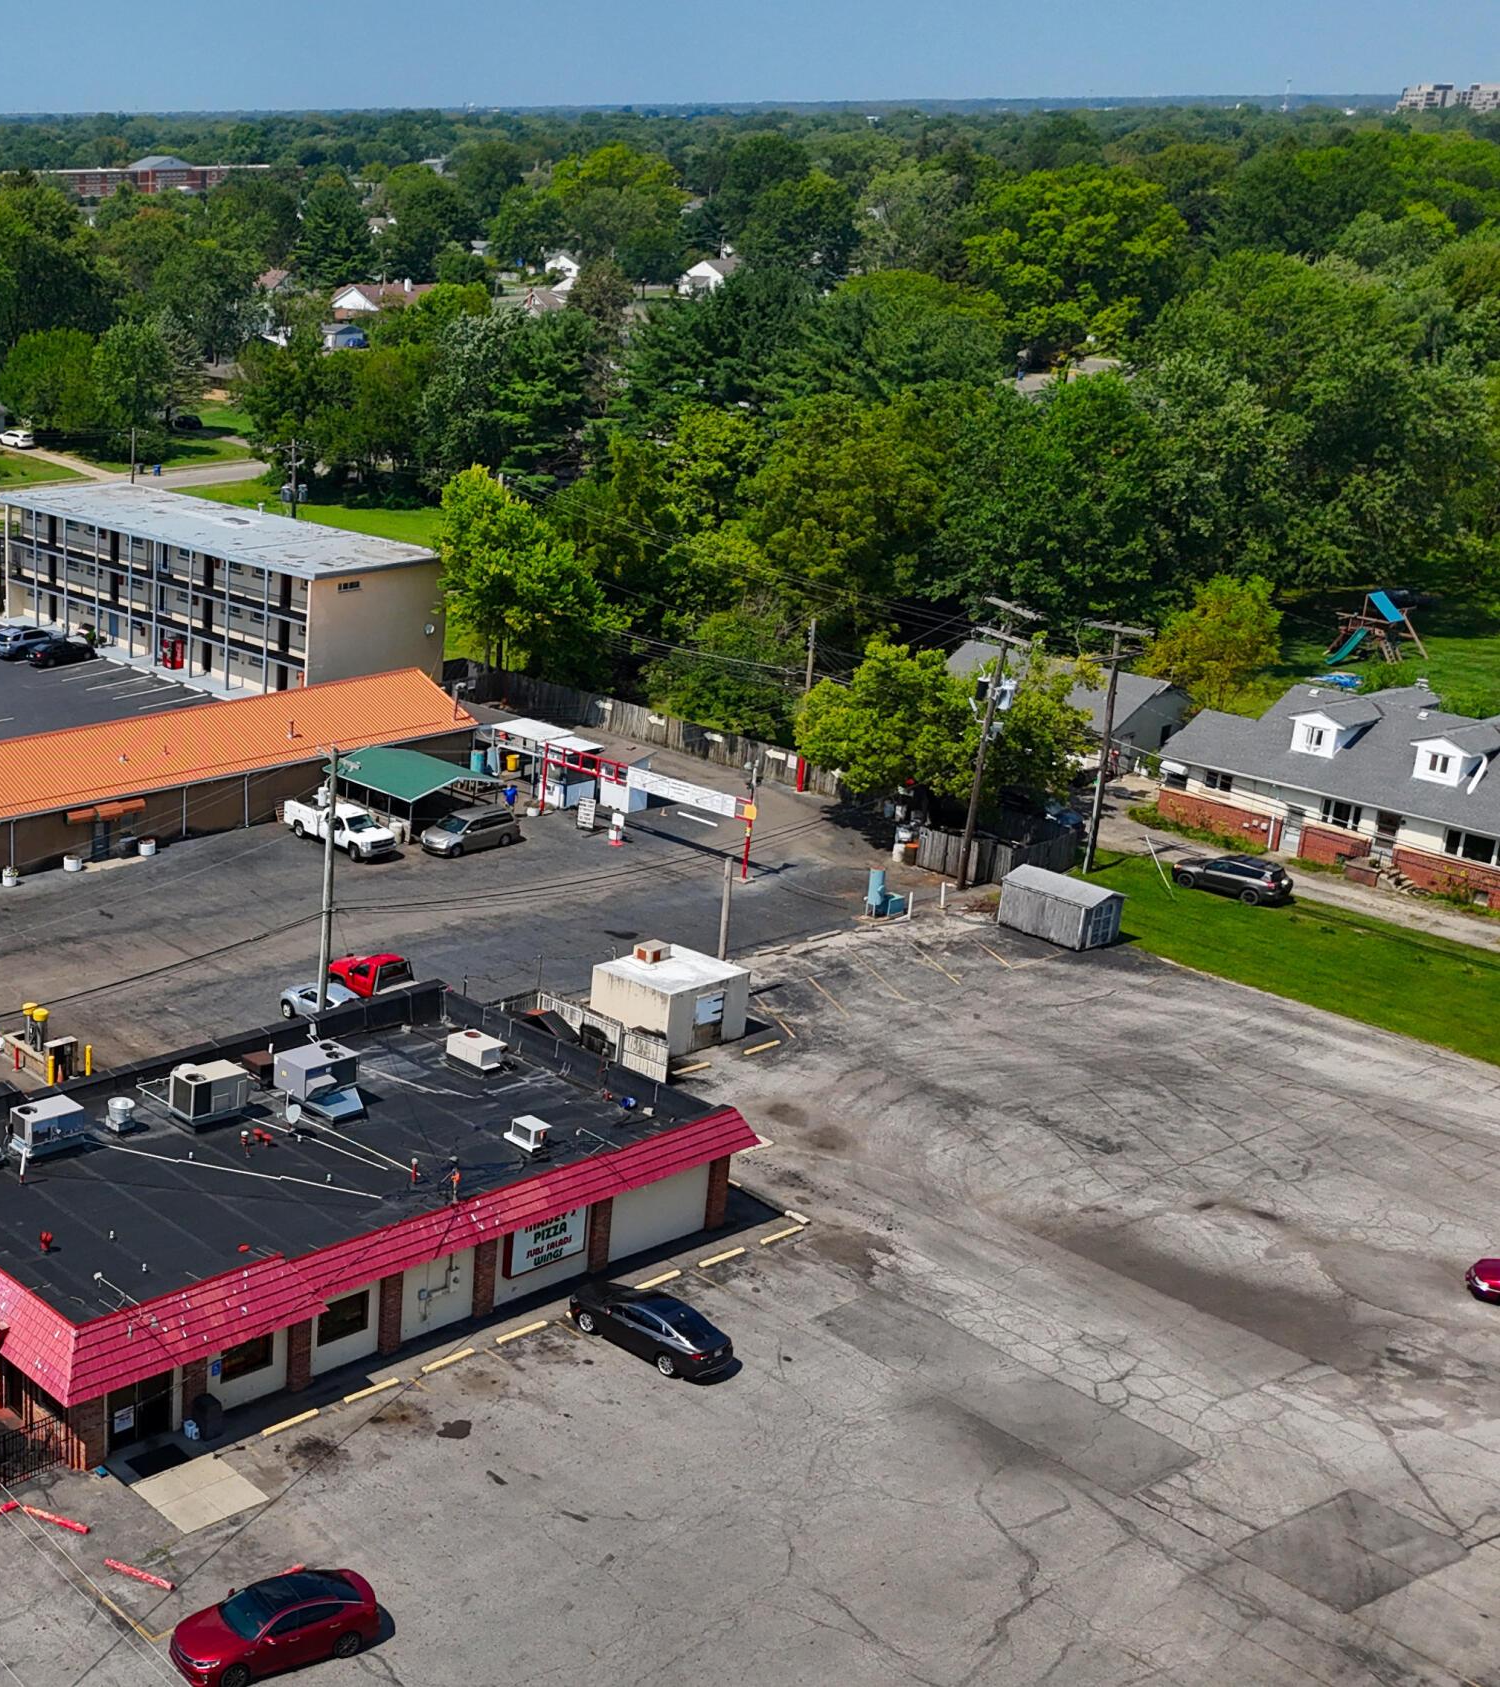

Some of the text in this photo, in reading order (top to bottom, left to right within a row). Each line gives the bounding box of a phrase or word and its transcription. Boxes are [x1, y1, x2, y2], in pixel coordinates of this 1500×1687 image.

[533, 1221, 567, 1244] PIZZA
[526, 1234, 573, 1259] SUBS SALADS
[533, 1247, 564, 1266] WINGS
